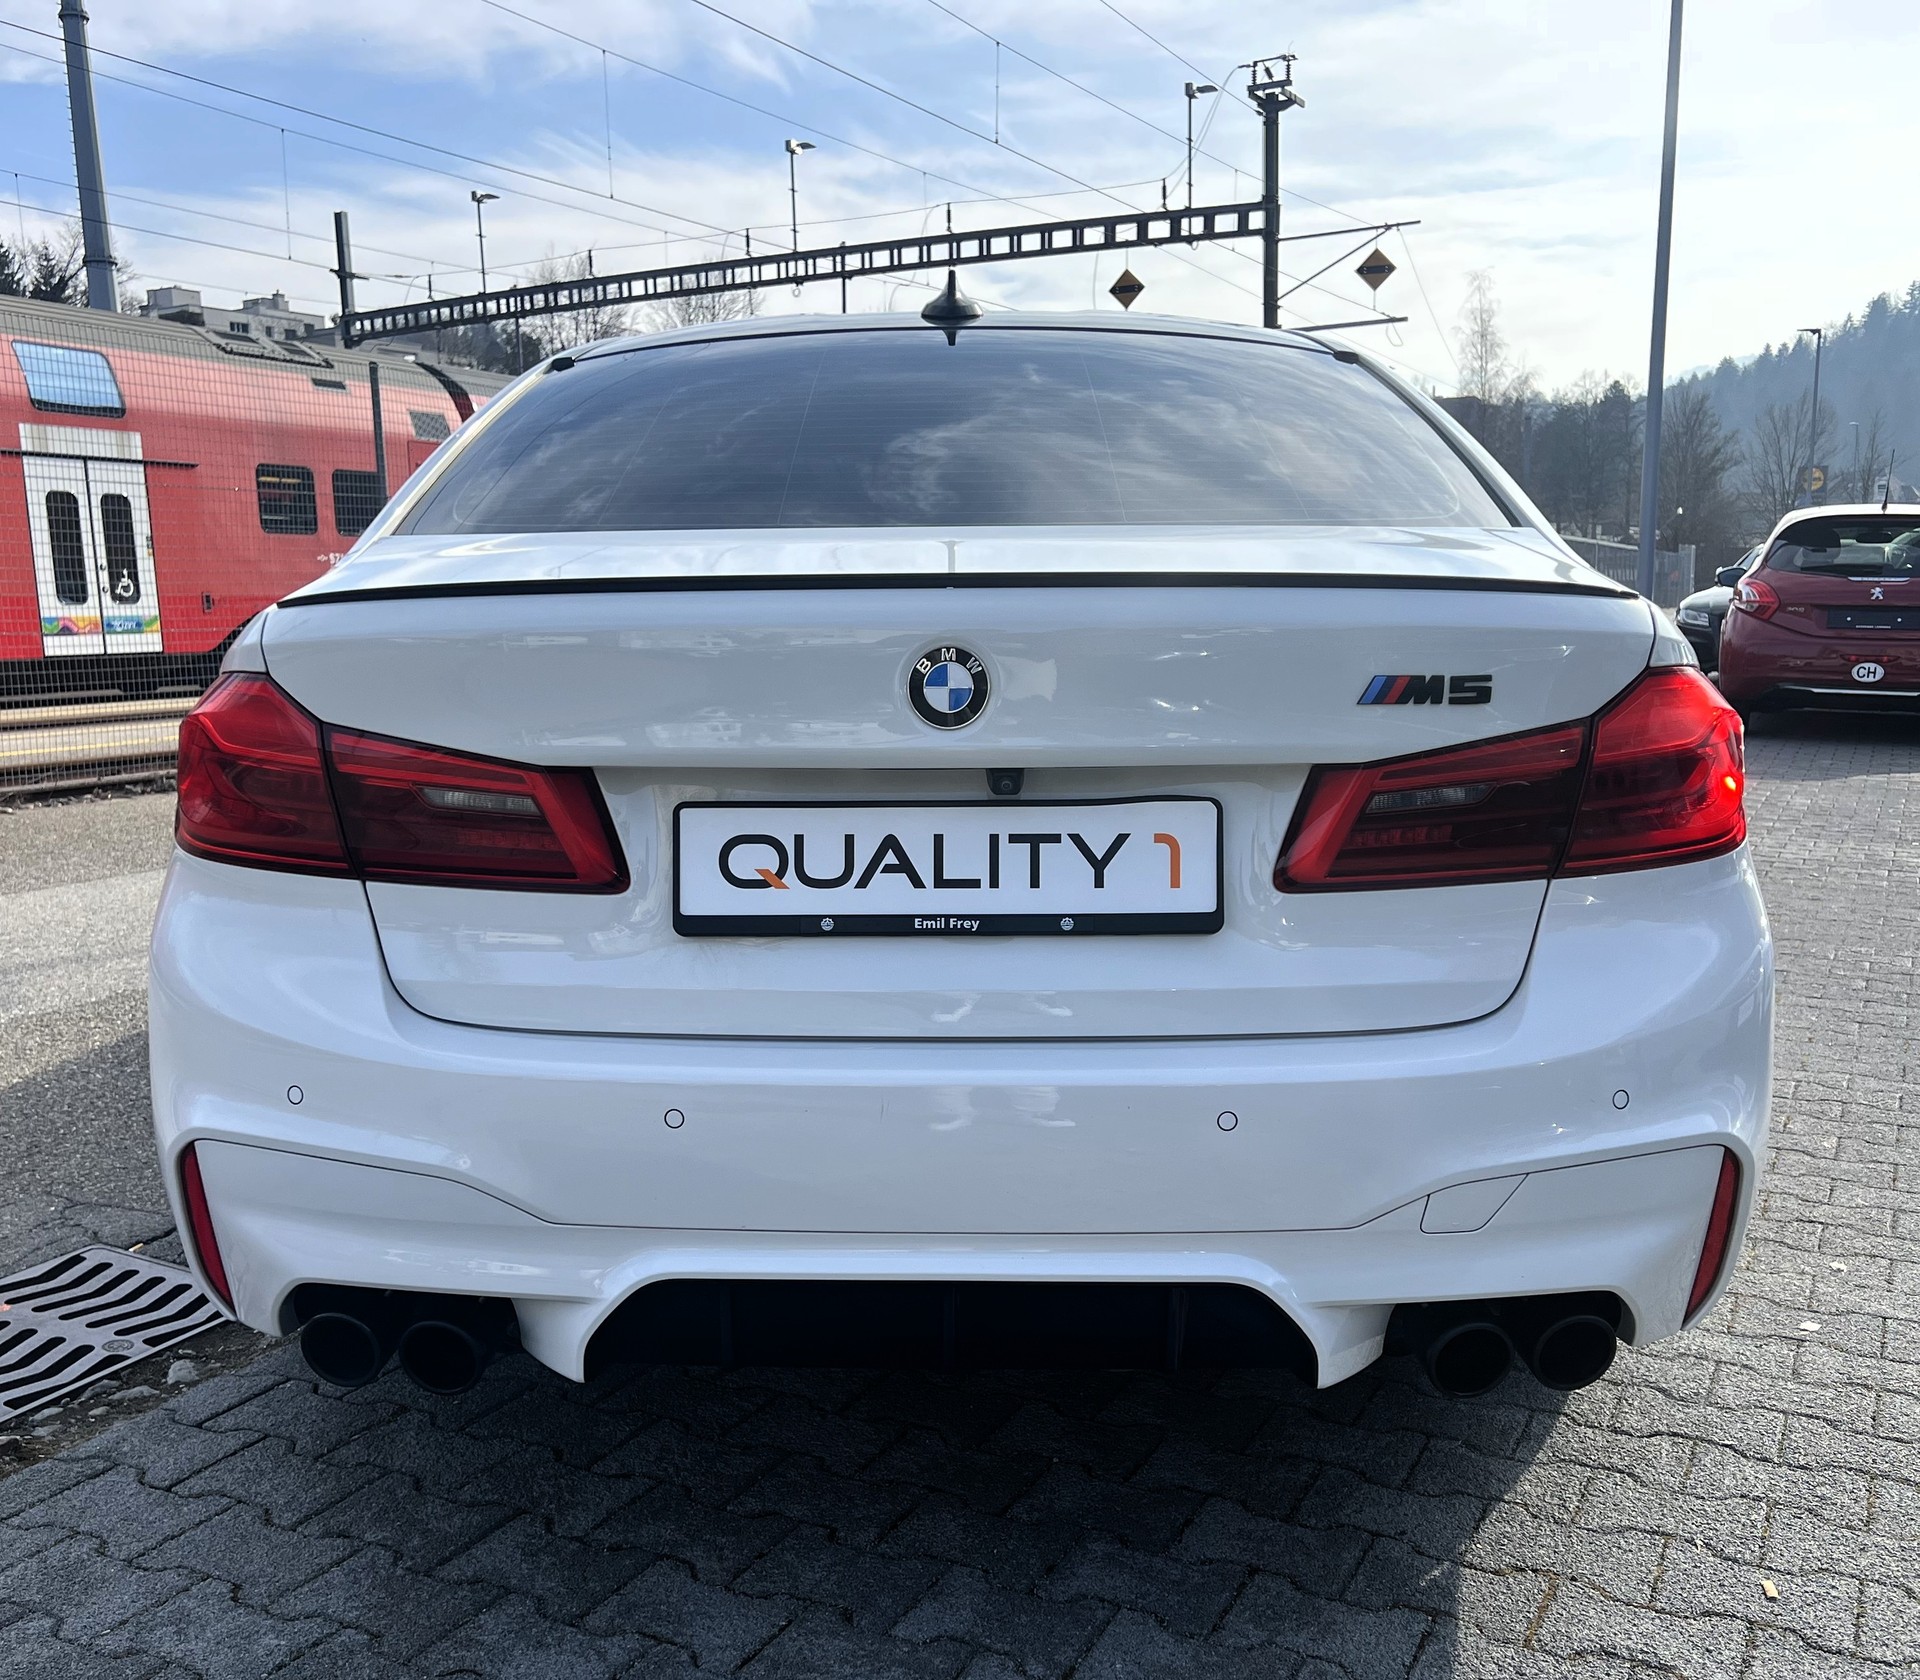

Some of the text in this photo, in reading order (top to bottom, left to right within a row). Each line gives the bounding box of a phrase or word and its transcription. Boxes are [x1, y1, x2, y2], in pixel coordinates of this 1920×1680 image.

[915, 647, 983, 675] BMW
[1856, 666, 1878, 679] CH
[1393, 674, 1493, 704] M5
[718, 833, 1181, 889] QUALITY 1
[914, 917, 980, 932] Emil Frey
